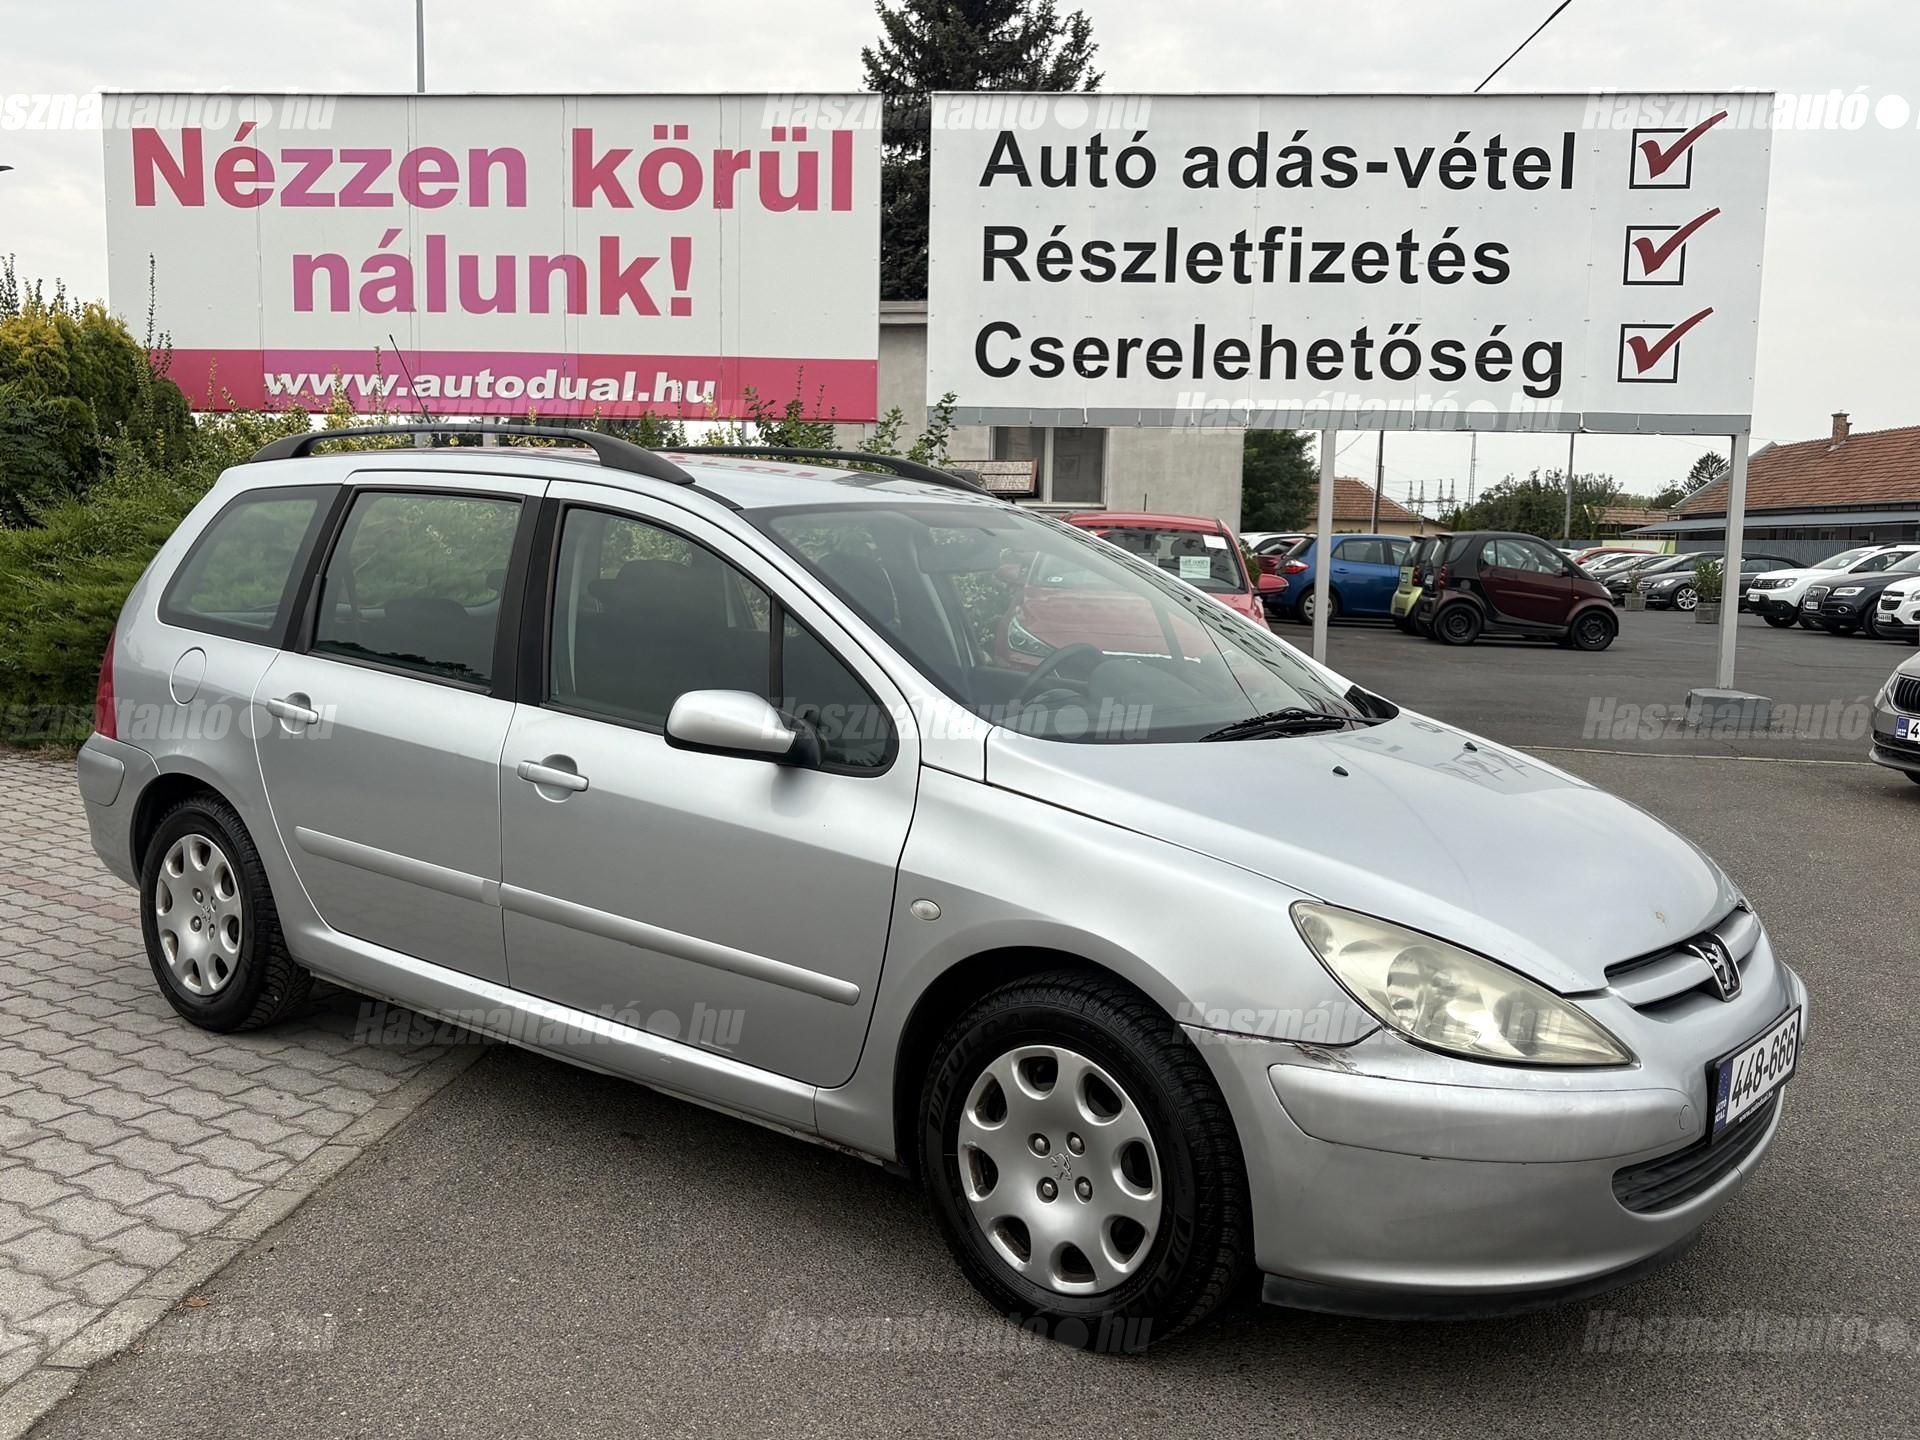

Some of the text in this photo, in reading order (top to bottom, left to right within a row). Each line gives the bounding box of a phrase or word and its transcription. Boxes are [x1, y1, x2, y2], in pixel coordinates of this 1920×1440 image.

[133, 122, 853, 212] Nézzen körül
[978, 130, 1576, 190] Autó adás-vétel
[294, 229, 693, 316] nálunk!
[983, 224, 1511, 285] Részletfizetés
[264, 367, 716, 404] www.autodual.hu
[974, 320, 1564, 398] Cserelehetőség
[1731, 1021, 1796, 1108] 448-666
